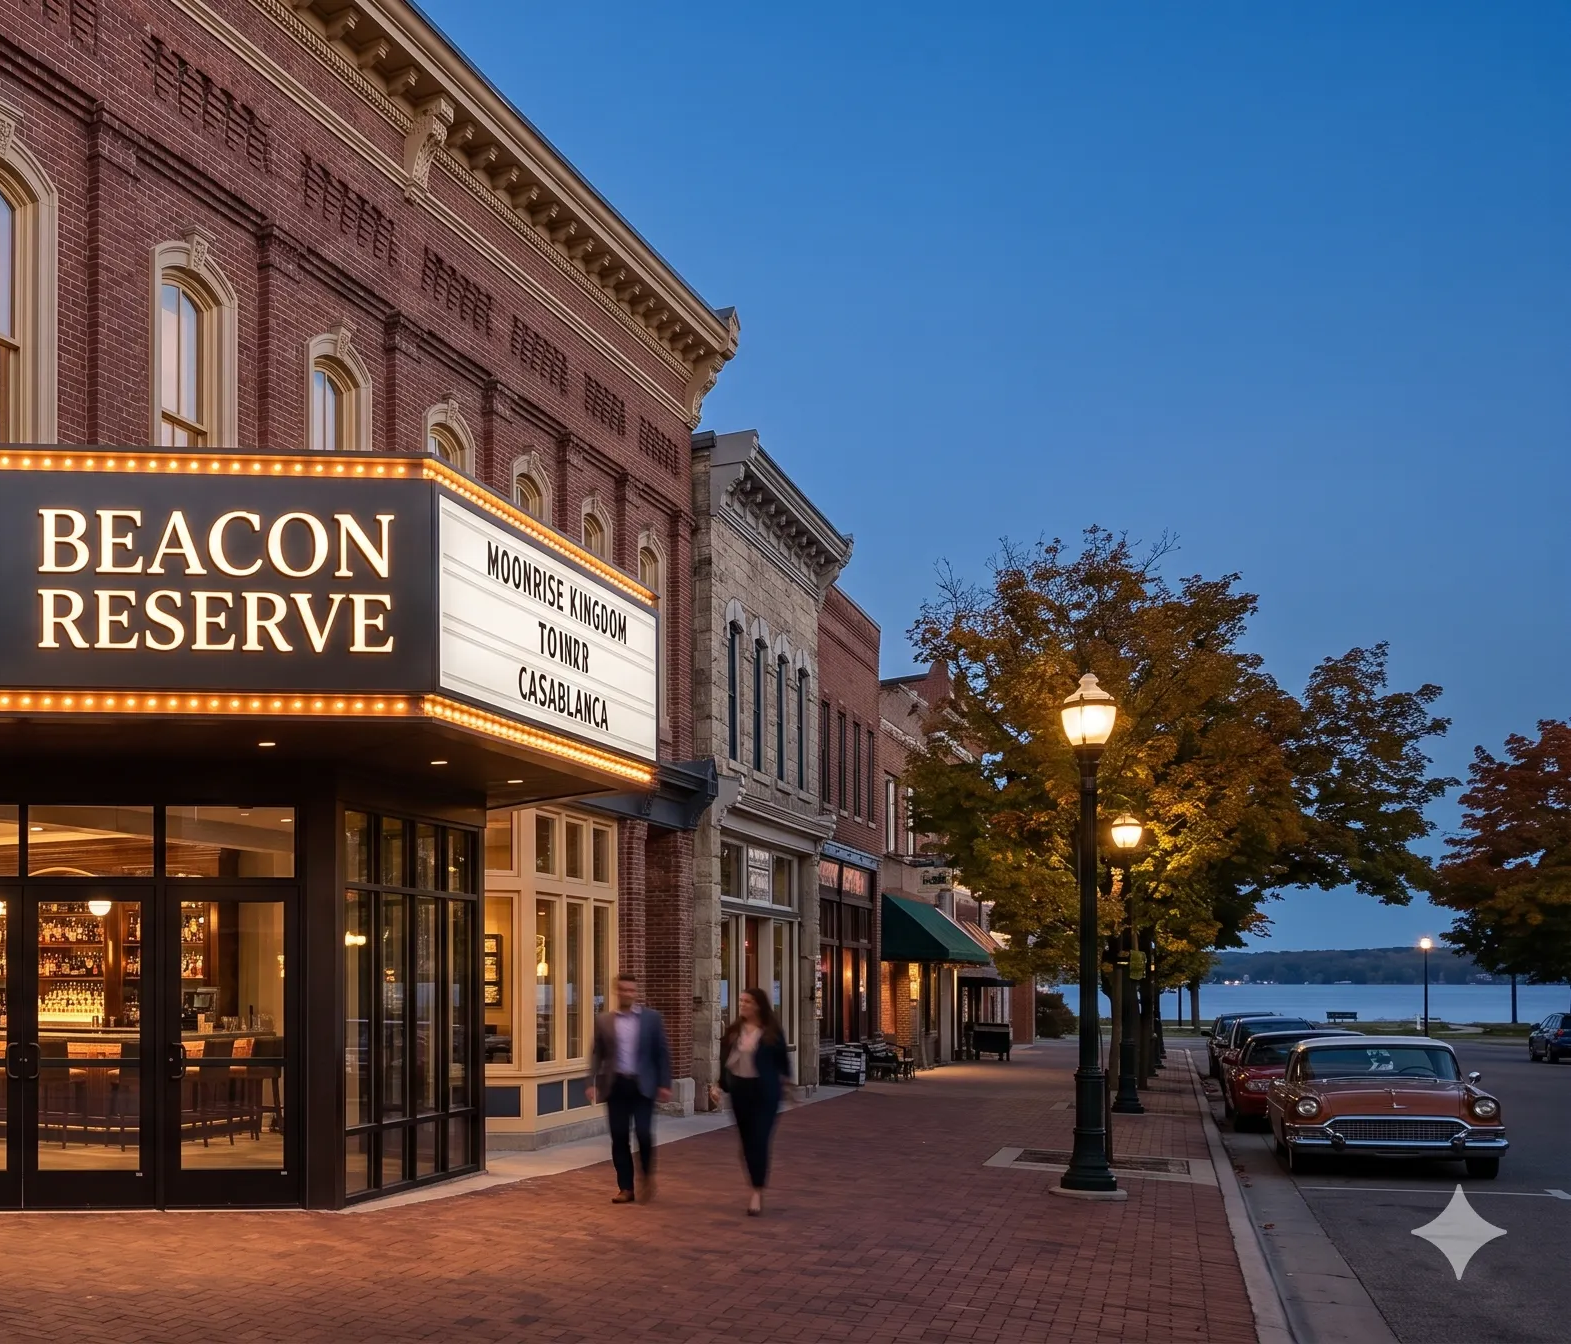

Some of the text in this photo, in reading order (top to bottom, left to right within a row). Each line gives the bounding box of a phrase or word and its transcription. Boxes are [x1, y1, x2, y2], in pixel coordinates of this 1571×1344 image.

[37, 508, 395, 578] BEACON
[37, 588, 394, 653] RESERVE
[487, 540, 627, 645] MOONRISE KINGDOM
[518, 666, 609, 731] CASABLANCA
